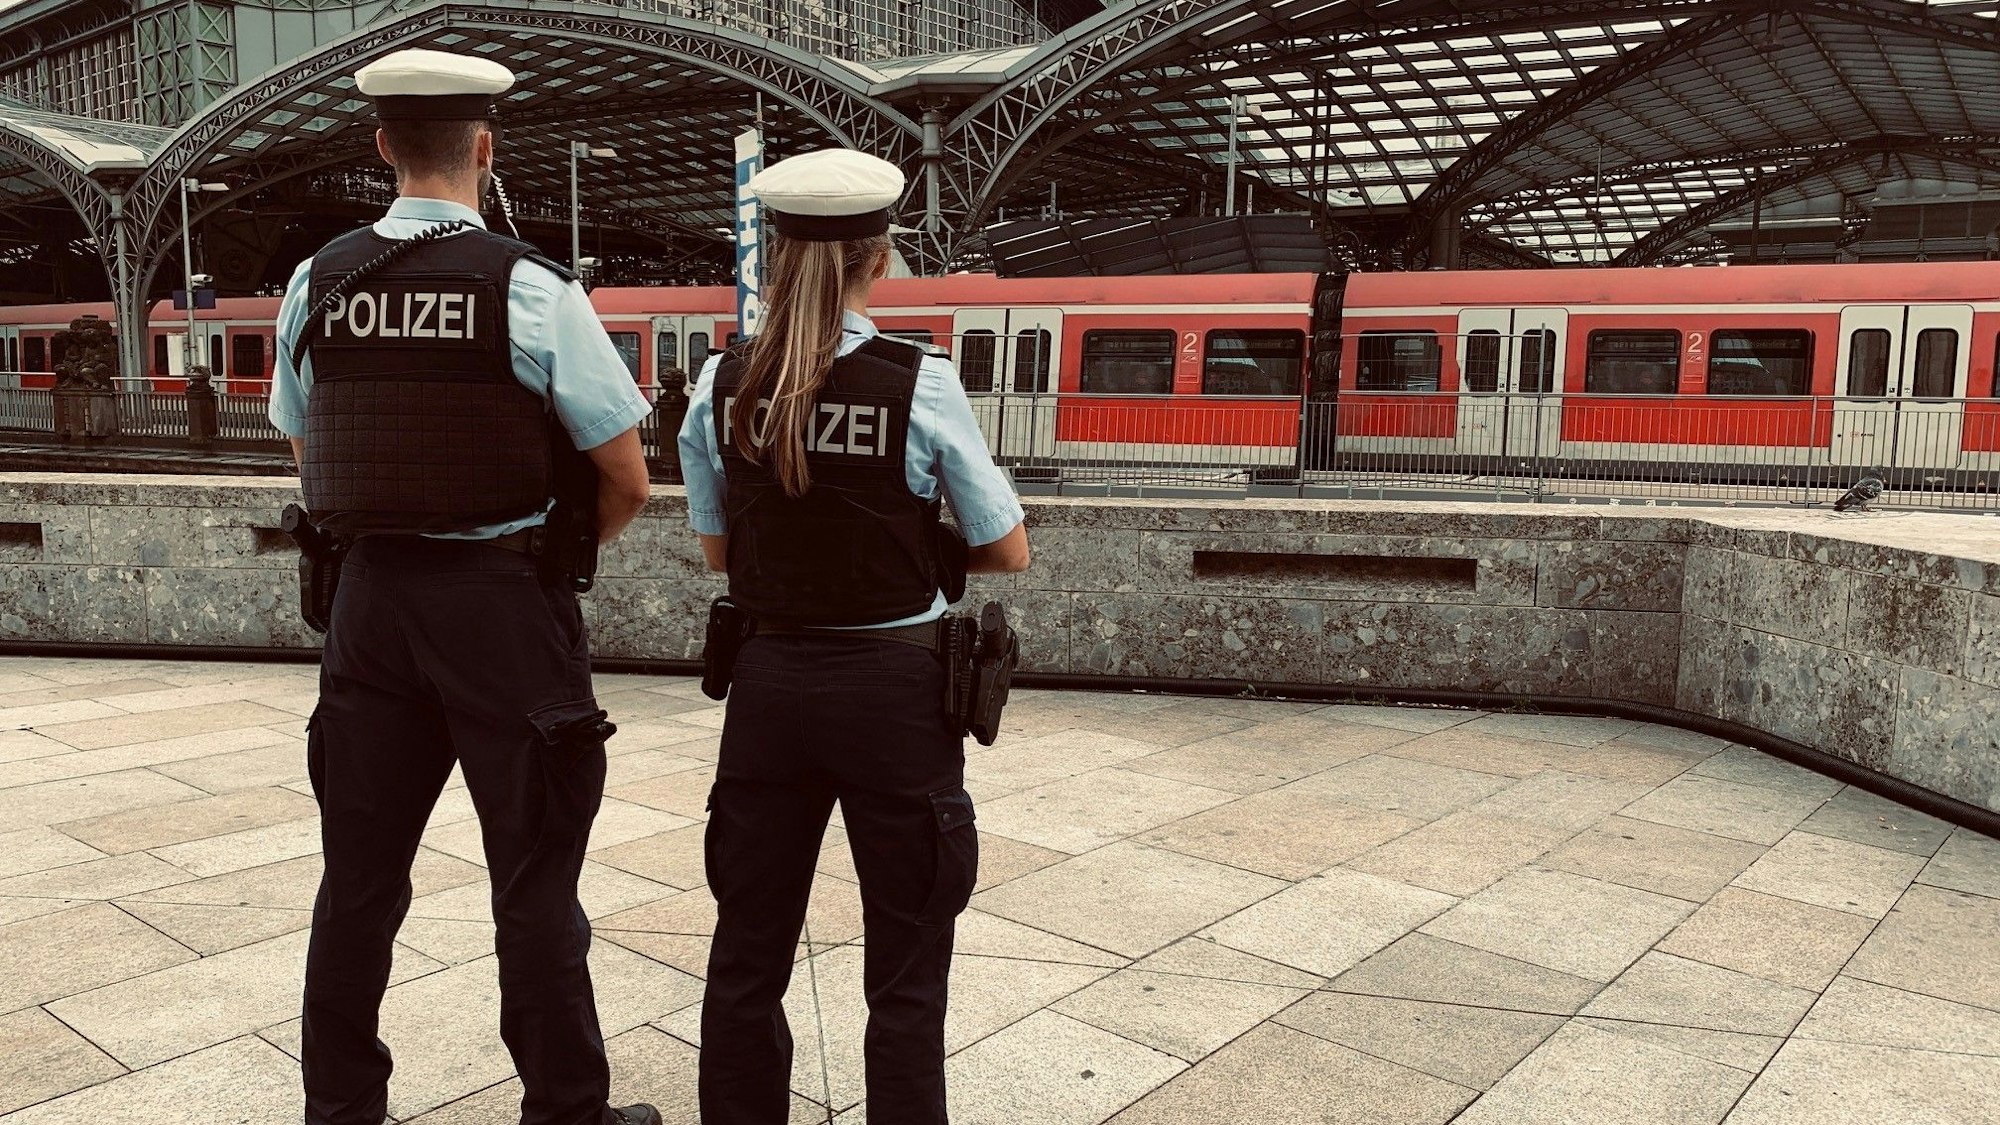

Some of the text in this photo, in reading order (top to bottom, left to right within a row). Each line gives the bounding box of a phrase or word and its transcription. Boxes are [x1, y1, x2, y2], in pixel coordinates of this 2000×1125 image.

[324, 291, 475, 339] POLIZEI
[1182, 332, 1198, 353] 2
[1687, 332, 1703, 353] 2
[723, 396, 889, 457] POIZEI
